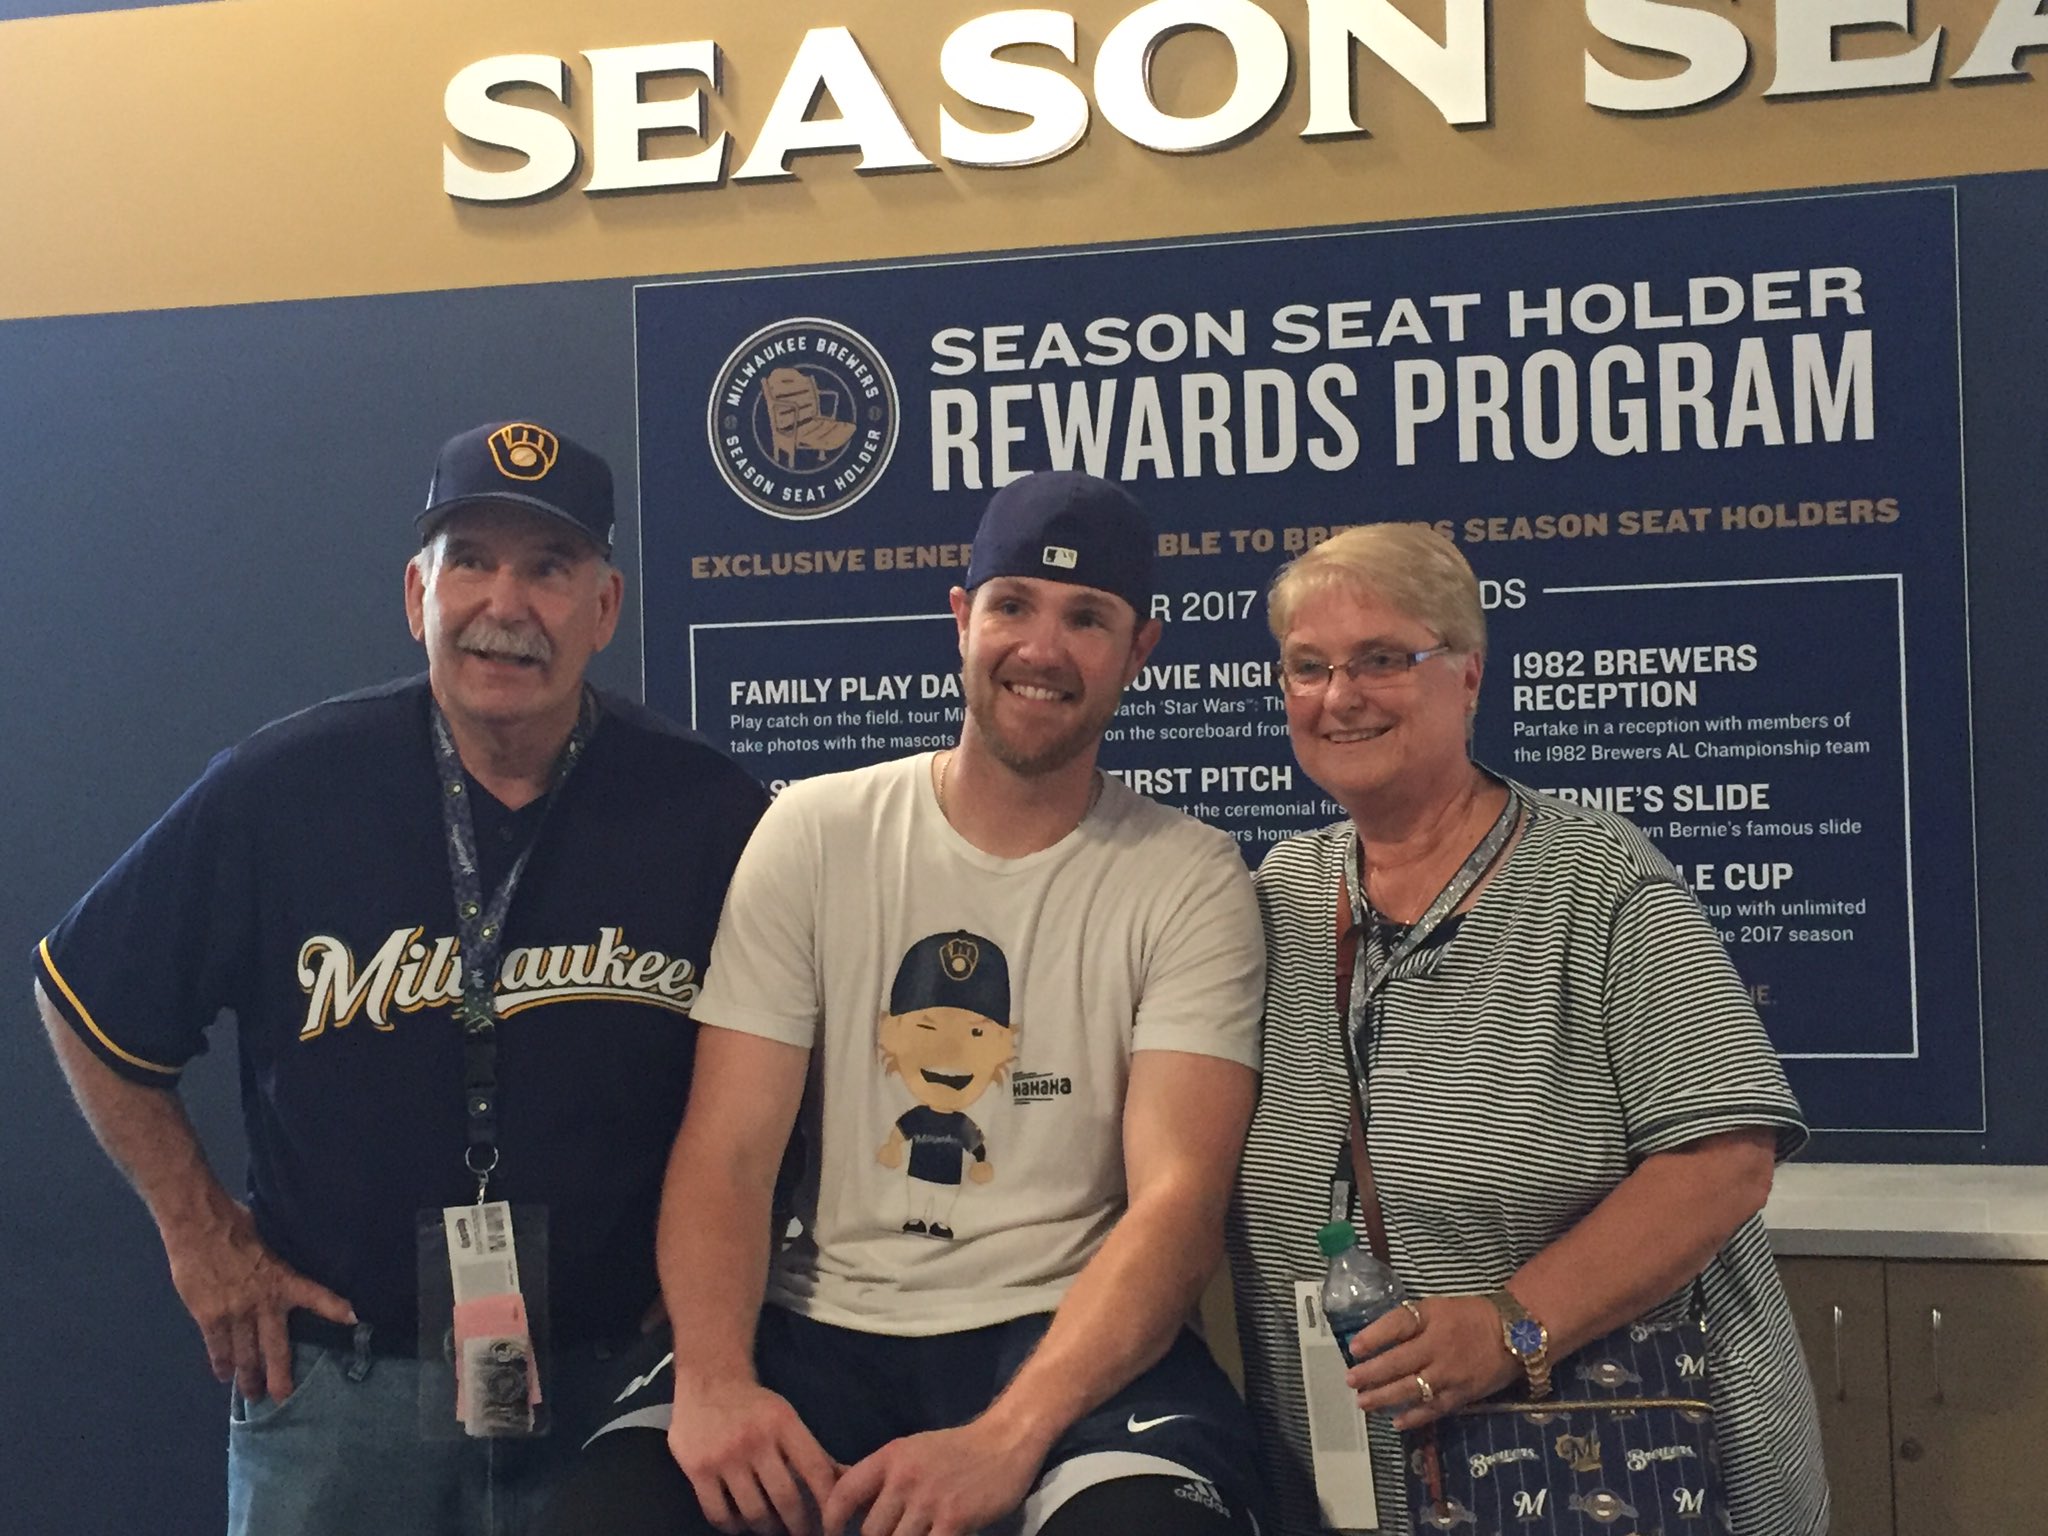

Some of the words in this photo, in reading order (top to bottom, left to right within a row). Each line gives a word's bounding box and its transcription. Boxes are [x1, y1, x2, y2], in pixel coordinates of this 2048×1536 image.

[443, 0, 1488, 202] SEASON
[930, 310, 1246, 377] SEASON
[1271, 292, 1481, 354] SEAT
[1509, 266, 1865, 338] HOLDER
[726, 336, 808, 407] MILWAUKEE
[816, 337, 880, 399] BREWERS
[930, 362, 1360, 492] REWARDS
[1394, 329, 1875, 466] PROGRAM
[726, 435, 776, 495] SEASON
[782, 485, 826, 502] SEAT
[834, 429, 882, 491] HOLDER
[691, 549, 865, 579] EXCLUSIVE
[1229, 528, 1275, 553] TO
[1464, 512, 1608, 543] SEASON
[1618, 507, 1711, 535] SEAT
[1721, 498, 1900, 530] HOLDERS
[1182, 590, 1257, 621] 2017
[1513, 651, 1585, 679] 1982
[1594, 644, 1758, 676] BREWERS
[730, 678, 832, 706] FAMILY
[840, 675, 912, 702] PLAY
[1123, 664, 1201, 691] OVIE
[1513, 680, 1697, 711] RECEPTION
[730, 714, 763, 732] Play
[767, 711, 809, 729] catch
[813, 712, 832, 726] on
[836, 710, 861, 726] the
[907, 708, 939, 724] tour
[1105, 729, 1125, 742] on
[1130, 726, 1156, 740] the
[1159, 721, 1252, 738] scoreboard
[1513, 720, 1579, 736] Partake
[1583, 719, 1599, 735] in
[1603, 722, 1614, 734] a
[1618, 717, 1700, 736] reception
[1704, 714, 1742, 731] with
[1747, 714, 1829, 731] members
[1833, 711, 1852, 728] of
[730, 736, 764, 753] take
[767, 735, 820, 755] photos
[823, 734, 857, 751] with
[860, 733, 886, 748] the
[890, 732, 955, 748] mascots
[1513, 746, 1541, 763] the
[1547, 744, 1586, 761] 1982
[1592, 743, 1662, 760] Brewers
[1666, 742, 1690, 759] AL
[1694, 737, 1821, 759] Championship
[1825, 738, 1870, 754] team
[1201, 765, 1292, 793] PITCH
[1194, 802, 1220, 818] the
[1224, 800, 1315, 817] ceremonial
[1672, 783, 1770, 812] SLIDE
[1669, 821, 1742, 838] Bernie's
[1746, 820, 1814, 836] famous
[1818, 818, 1862, 834] slide
[1724, 862, 1793, 891] CUP
[1737, 901, 1776, 916] with
[1781, 898, 1866, 915] unlimited
[1740, 926, 1784, 942] 2017
[1788, 927, 1854, 941] season
[298, 925, 700, 1042] Milaukee
